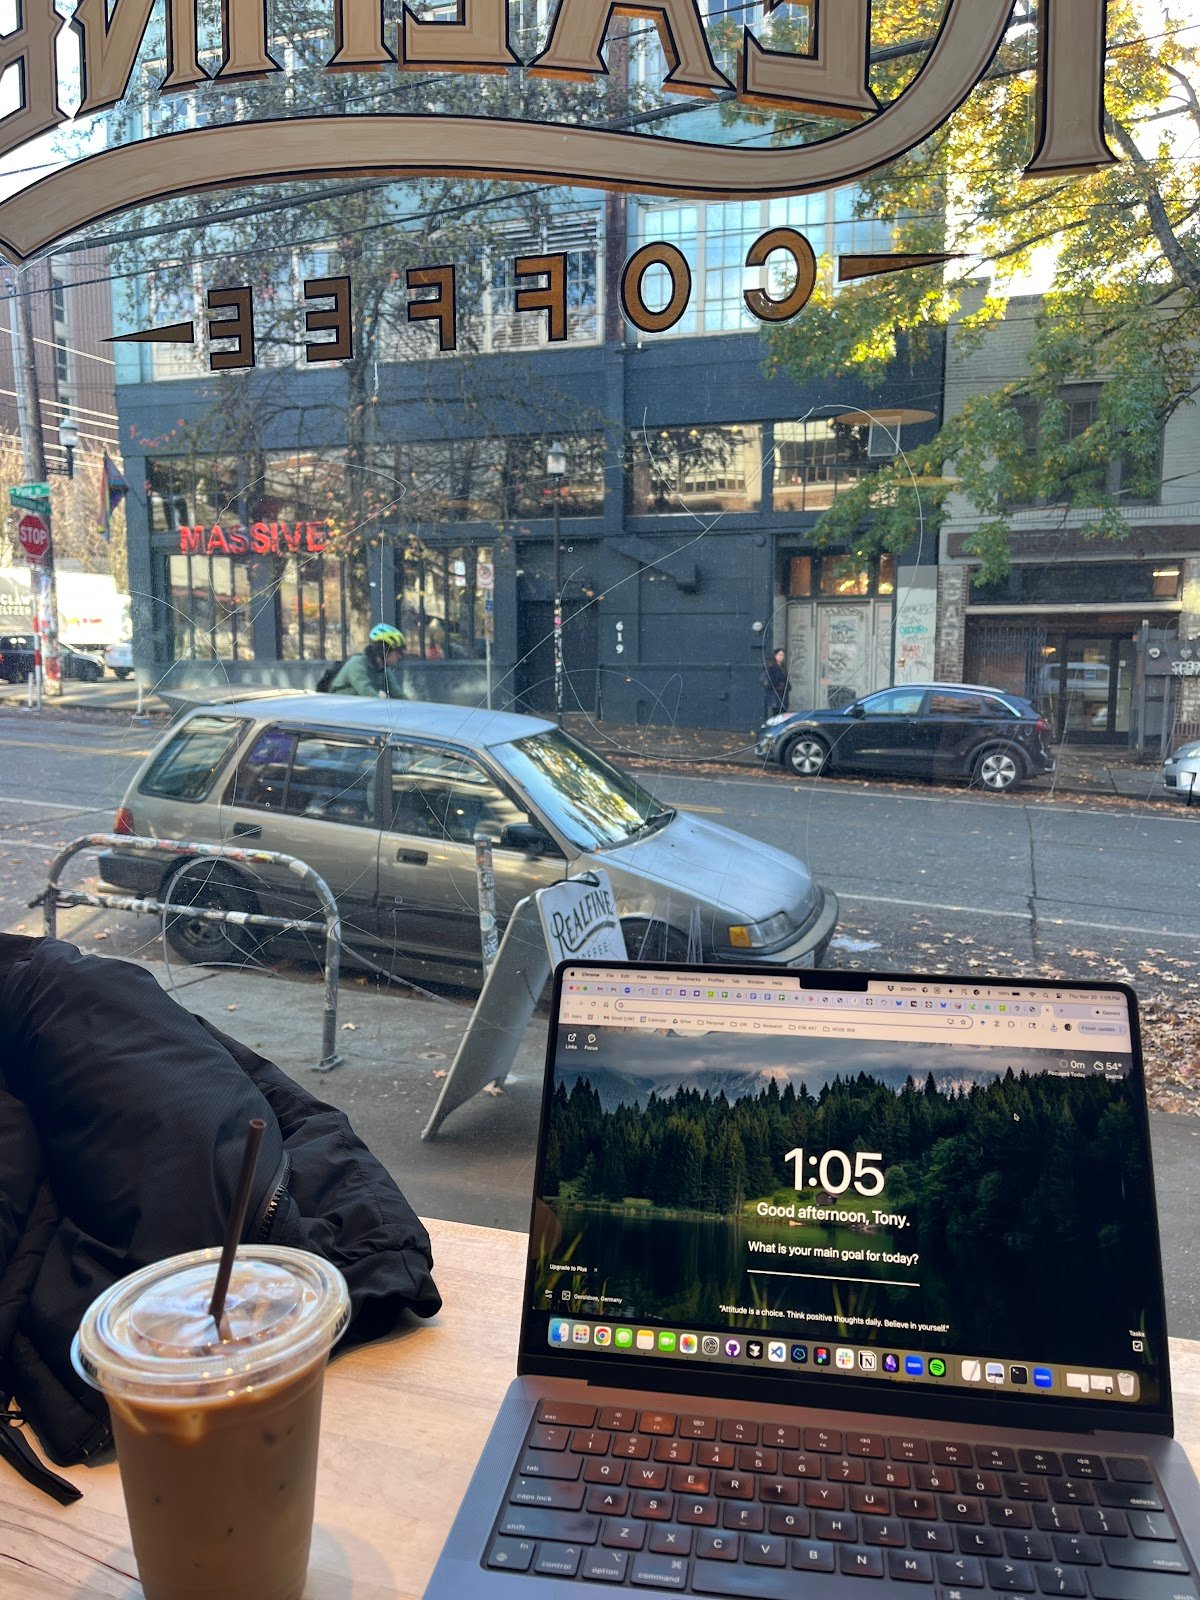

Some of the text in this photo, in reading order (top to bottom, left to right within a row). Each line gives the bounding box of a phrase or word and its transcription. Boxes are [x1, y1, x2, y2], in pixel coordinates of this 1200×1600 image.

[20, 526, 46, 545] STOP
[179, 521, 328, 555] MASSIVE
[616, 620, 624, 654] 619
[551, 889, 614, 959] REALFINE
[577, 941, 609, 959] OFFEE
[1070, 1060, 1086, 1070] 0m
[1106, 1062, 1122, 1070] 54°
[784, 1148, 885, 1197] 1:05
[756, 1202, 910, 1229] Good afternoon, Tony.
[748, 1240, 919, 1266] What is your main goal for today?
[550, 1264, 570, 1272] Upgrade
[601, 1296, 622, 1304] Germany
[749, 1307, 755, 1315] is
[761, 1308, 786, 1318] choice.
[786, 1310, 805, 1320] Think
[806, 1313, 832, 1322] positive
[834, 1315, 864, 1326] thoughts
[865, 1318, 883, 1328] daily.
[884, 1319, 909, 1329] Believe
[910, 1322, 917, 1330] in
[1128, 1330, 1146, 1338] Tasks
[864, 1357, 872, 1368] N
[601, 1466, 610, 1475] Q
[798, 1464, 806, 1472] 6
[642, 1470, 654, 1478] W
[887, 1474, 894, 1482] 8
[687, 1475, 695, 1484] E
[731, 1480, 739, 1488] R
[931, 1478, 939, 1486] 9
[775, 1485, 783, 1493] T
[976, 1482, 985, 1490] 0
[820, 1490, 828, 1498] Y
[604, 1496, 613, 1504] A
[865, 1495, 874, 1503] U
[649, 1500, 657, 1509] S
[957, 1503, 967, 1513] O
[694, 1505, 703, 1514] D
[1004, 1508, 1013, 1517] P
[741, 1511, 748, 1519] F
[785, 1515, 794, 1525] G
[507, 1523, 526, 1532] shift
[832, 1521, 842, 1530] H
[620, 1528, 629, 1538] Z
[880, 1526, 887, 1535] J
[666, 1534, 675, 1543] X
[928, 1531, 936, 1540] K
[976, 1535, 984, 1544] L
[713, 1539, 722, 1548] C
[761, 1544, 770, 1554] V
[810, 1550, 818, 1560] B
[857, 1555, 867, 1565] N
[541, 1561, 571, 1571] control
[905, 1560, 917, 1570] M
[592, 1567, 619, 1576] option
[638, 1572, 680, 1584] command
